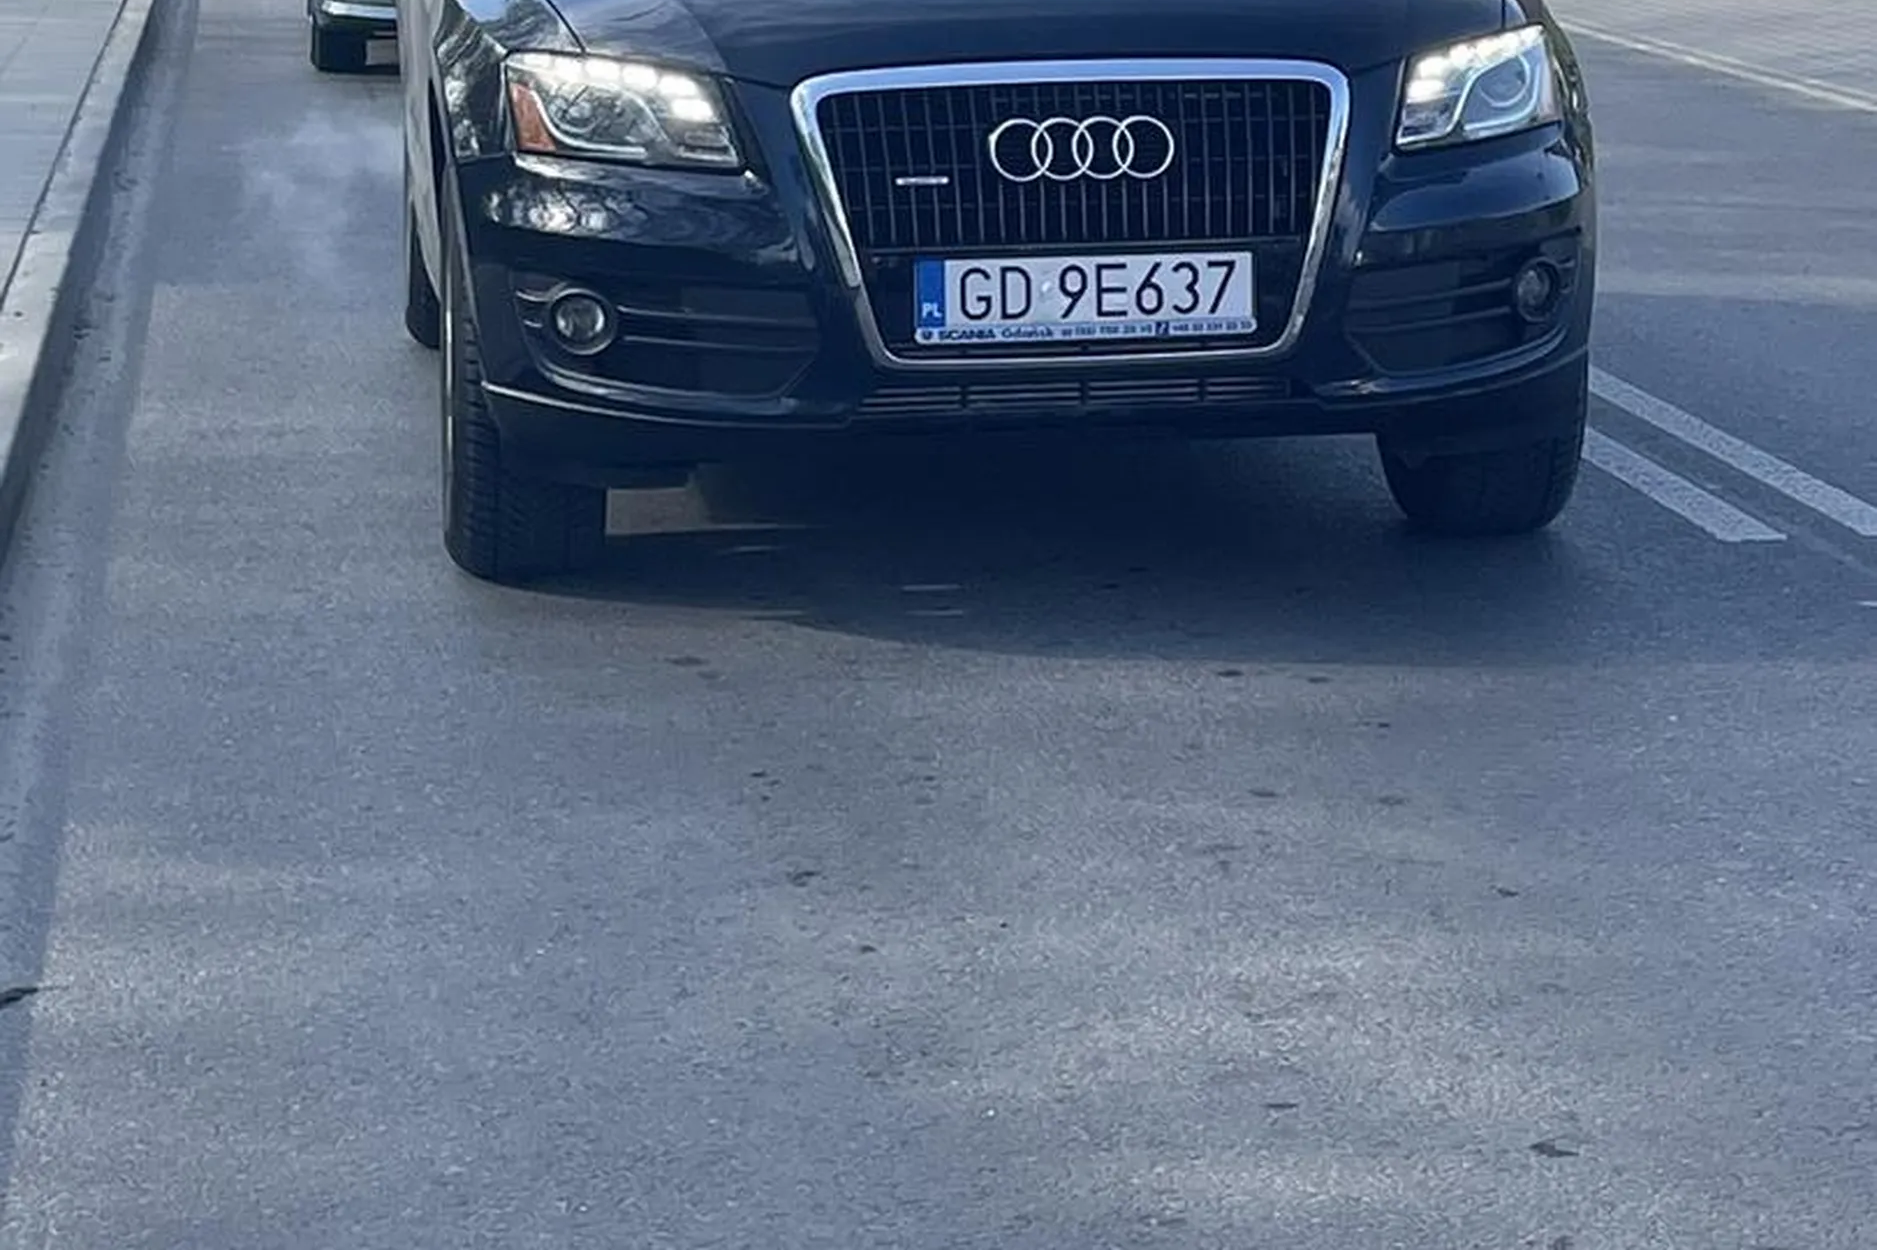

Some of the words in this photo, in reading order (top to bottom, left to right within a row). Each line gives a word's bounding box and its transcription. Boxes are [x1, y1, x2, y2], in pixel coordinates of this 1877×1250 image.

[960, 265, 1032, 321] GD
[1058, 261, 1237, 320] 9E637
[922, 302, 943, 319] PL
[938, 328, 996, 341] SCANIA
